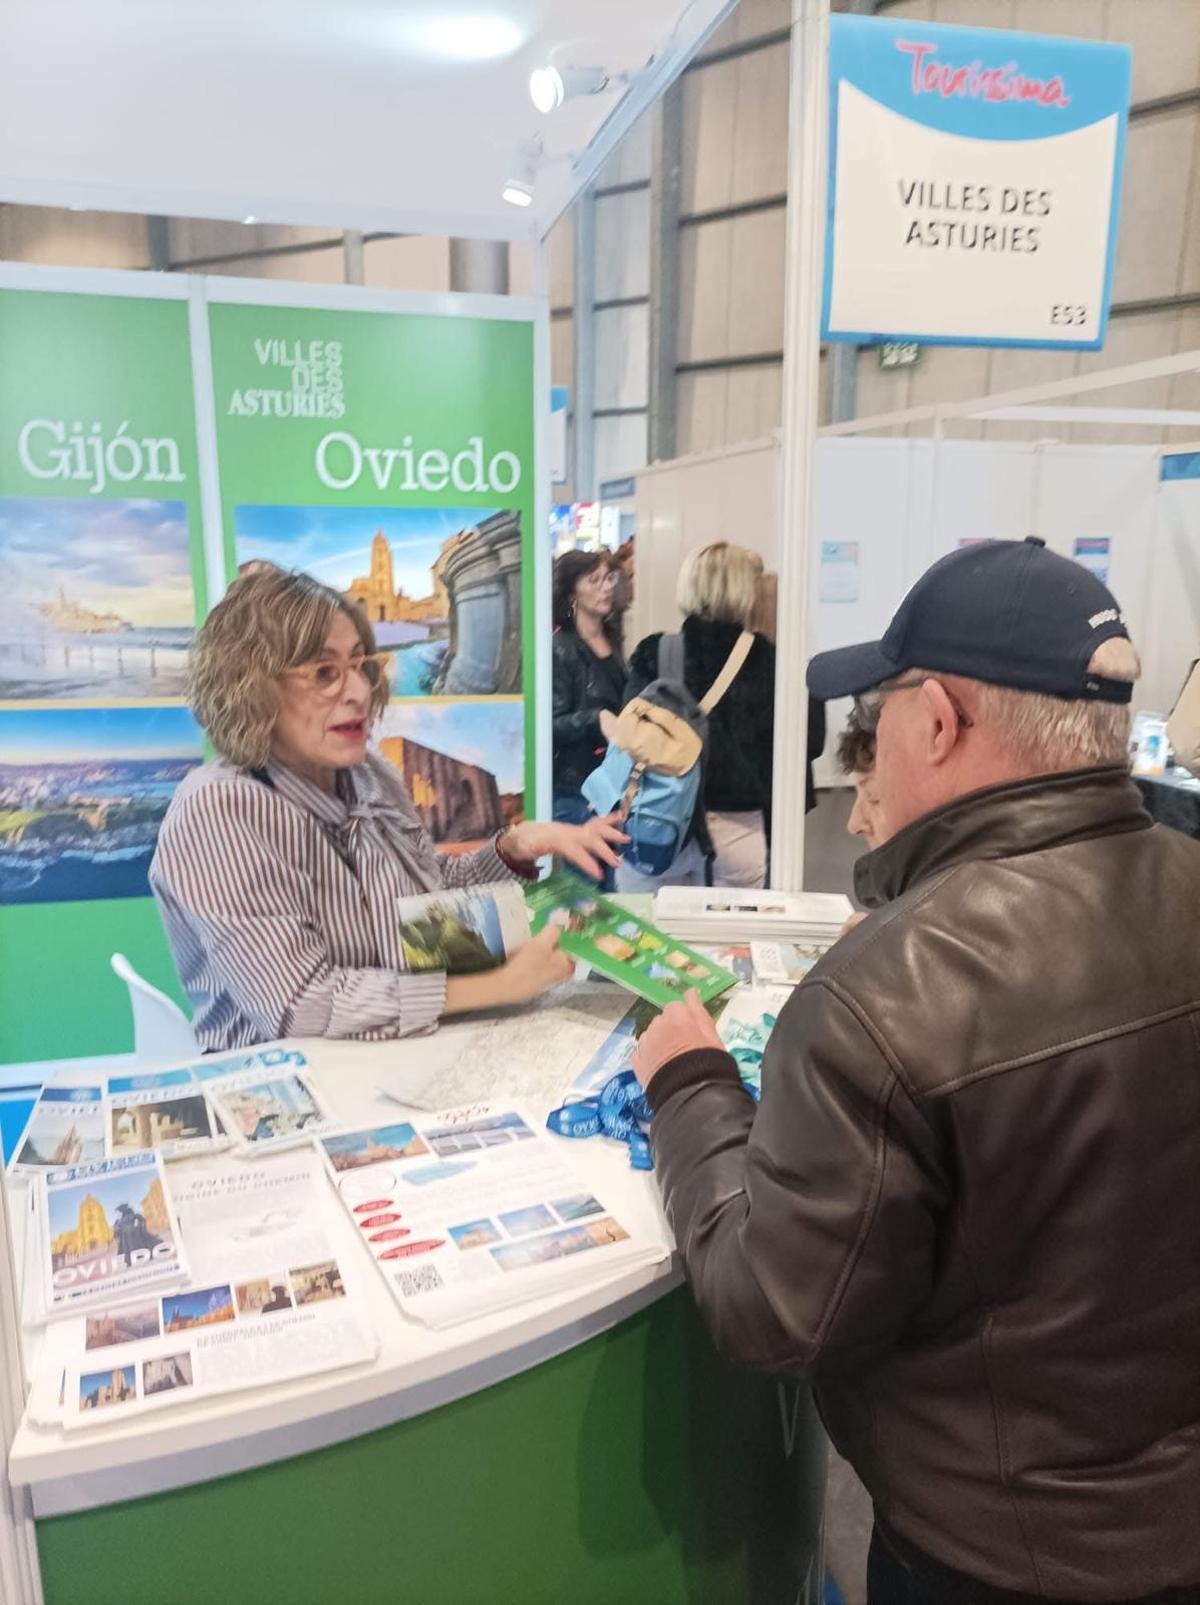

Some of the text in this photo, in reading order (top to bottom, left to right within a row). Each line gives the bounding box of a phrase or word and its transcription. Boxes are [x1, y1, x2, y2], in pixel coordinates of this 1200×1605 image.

[898, 179, 1052, 217] VILLES DES
[904, 220, 1040, 253] ASTURIES
[1051, 305, 1087, 325] E53
[253, 338, 343, 368] VILLES
[291, 364, 343, 393] DES
[227, 388, 346, 419] ASTURIES
[18, 418, 187, 495] Gijón
[315, 431, 522, 494] Oviedo
[53, 1242, 176, 1285] OVIEDO
